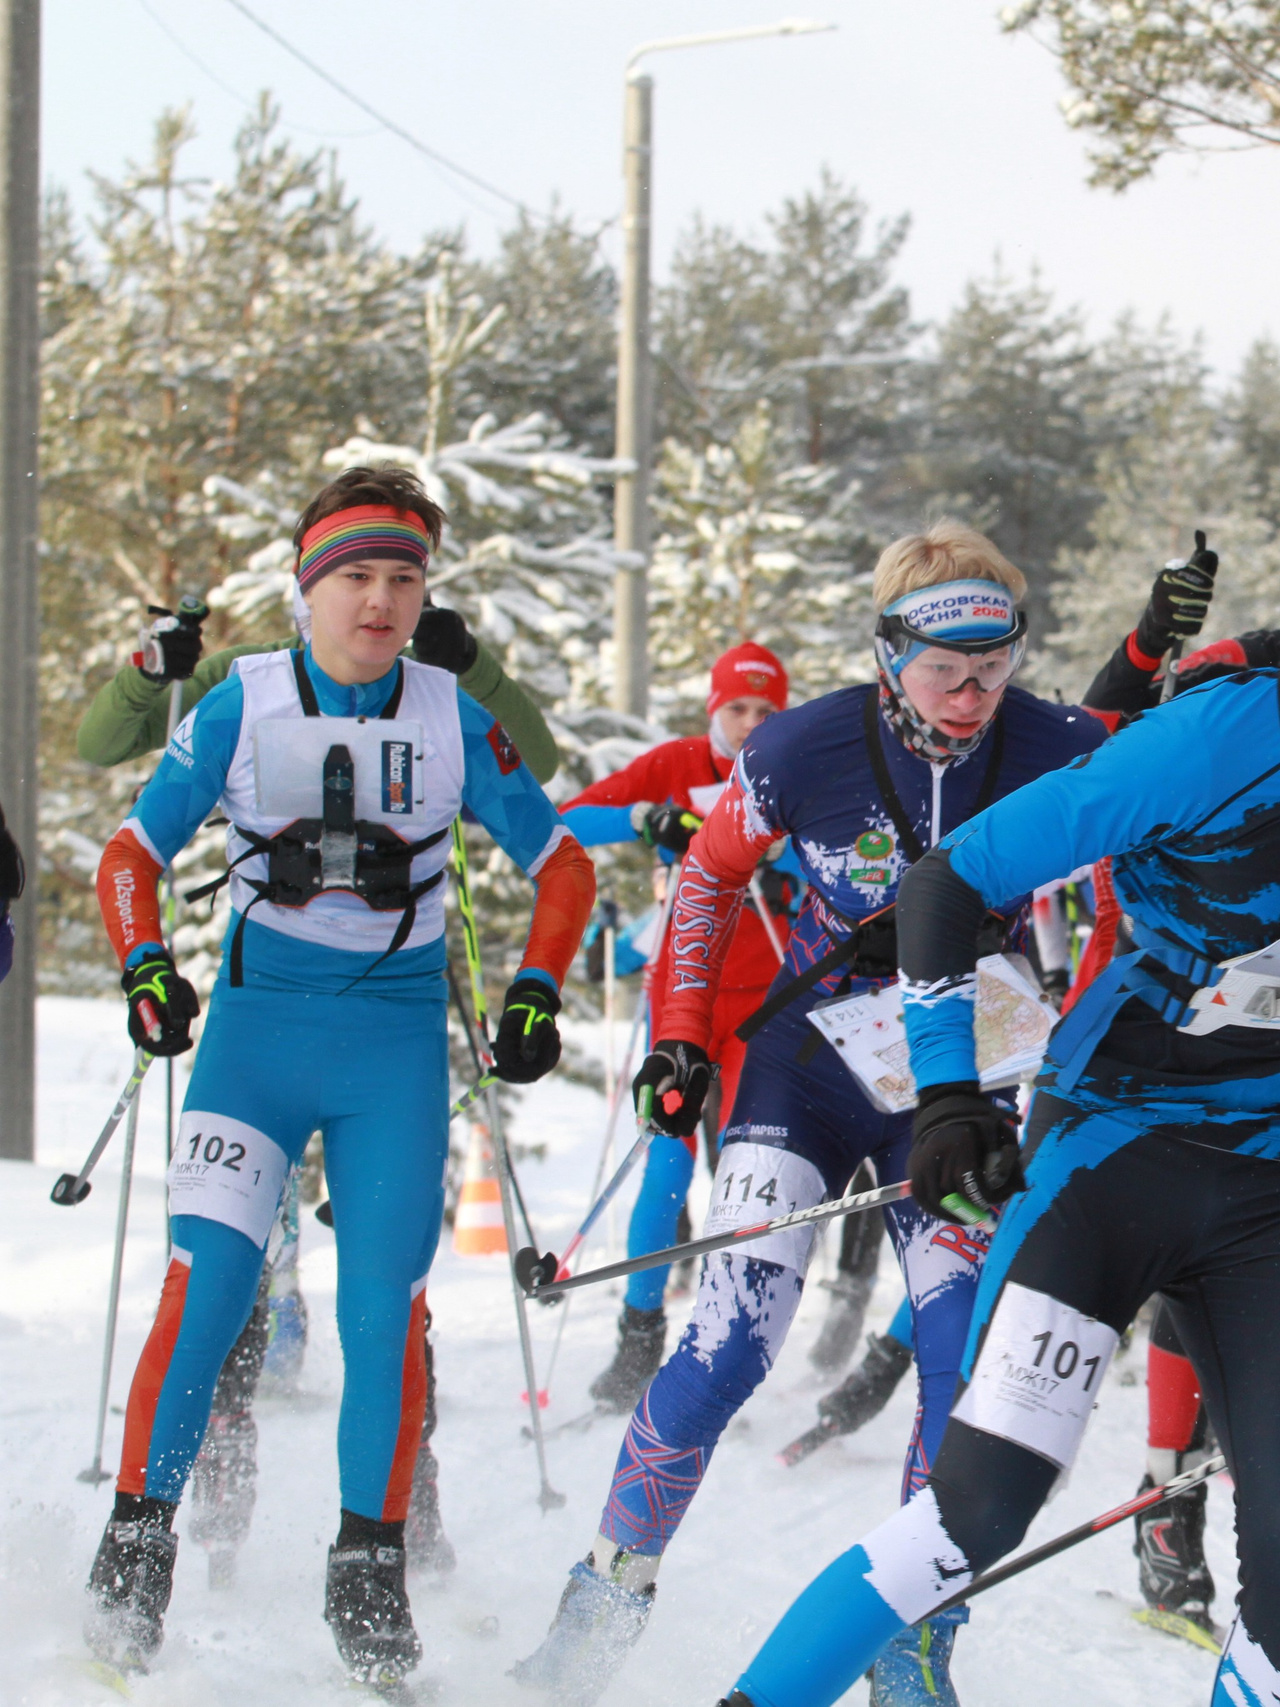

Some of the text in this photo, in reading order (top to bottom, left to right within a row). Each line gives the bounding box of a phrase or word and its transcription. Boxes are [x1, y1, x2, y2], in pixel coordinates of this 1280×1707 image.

[908, 595, 1009, 620] ОСКОВСКАЯ
[972, 607, 1008, 619] 2020
[188, 1132, 247, 1172] 102
[253, 1170, 262, 1186] 1
[723, 1172, 778, 1207] 114
[1032, 1330, 1102, 1392] 101
